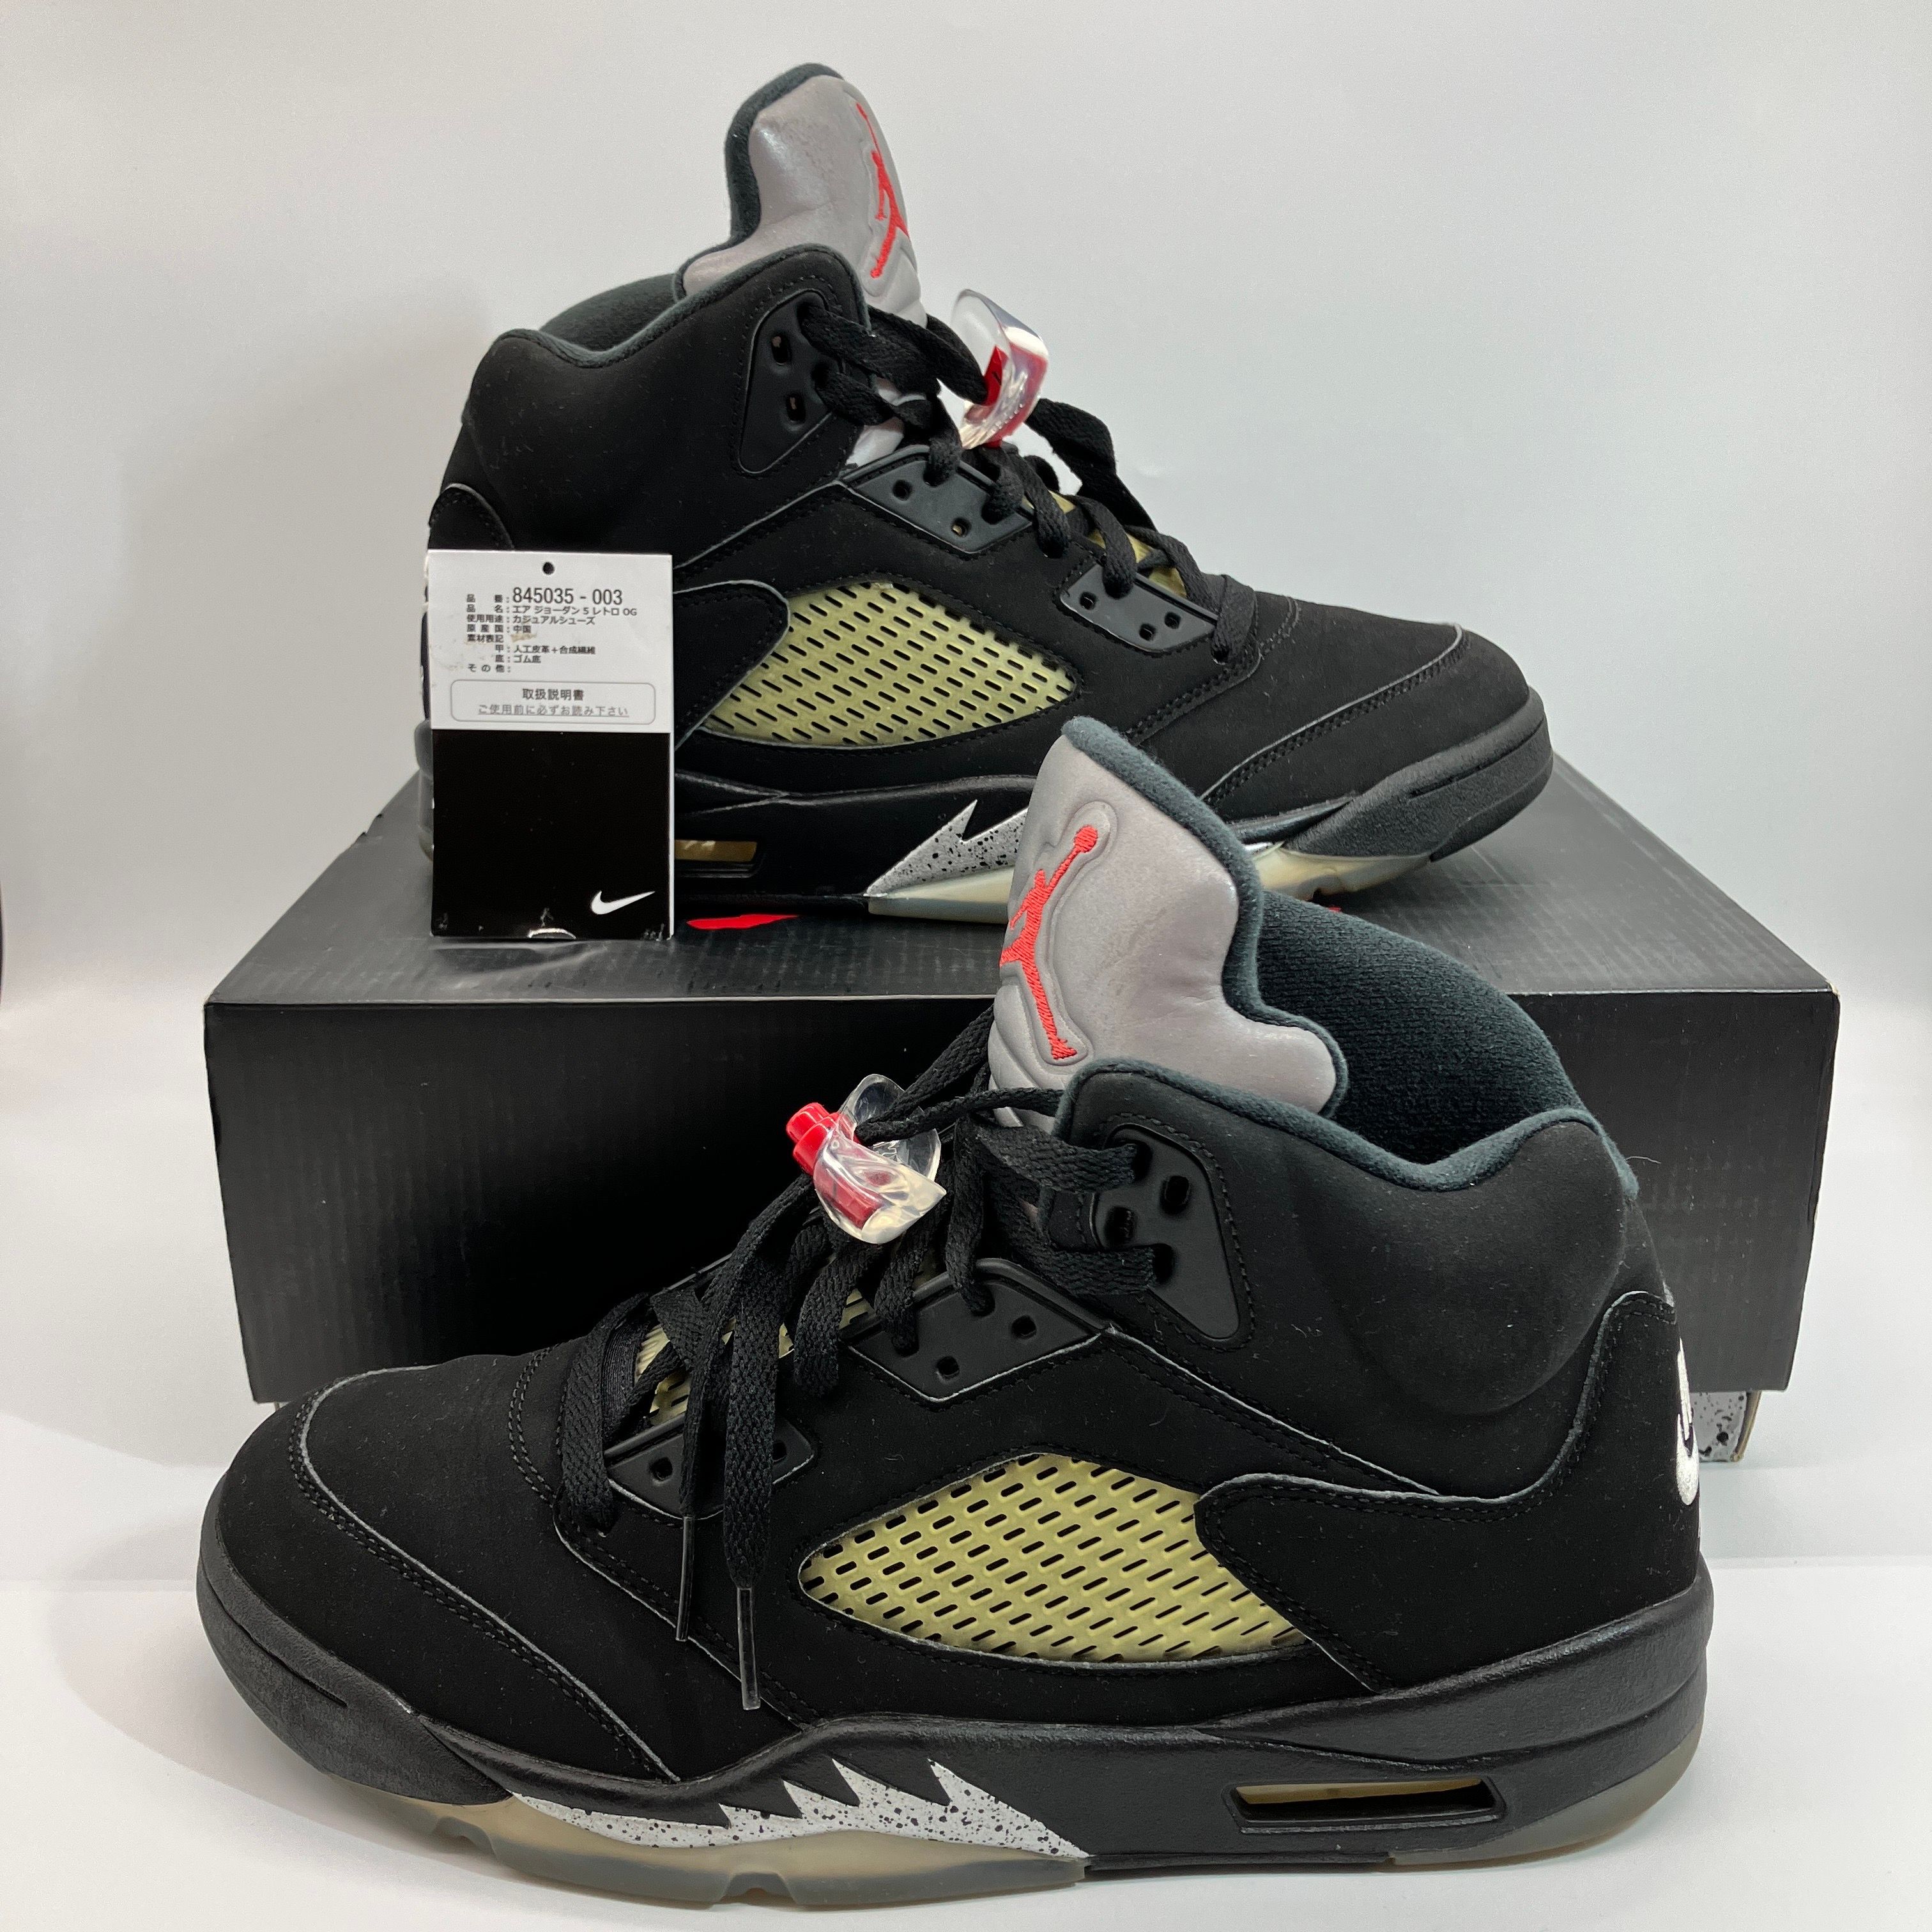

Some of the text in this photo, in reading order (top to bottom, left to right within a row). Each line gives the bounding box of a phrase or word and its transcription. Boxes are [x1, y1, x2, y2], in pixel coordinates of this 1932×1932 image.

[512, 587, 574, 604] 845035
[593, 589, 622, 605] 003
[534, 606, 579, 615] ジョーダン
[513, 625, 531, 634] 中国
[514, 655, 541, 663] ゴム底
[522, 688, 584, 701] 取扱説明書
[478, 704, 629, 717] ご使用前に必ずお読み下さい
